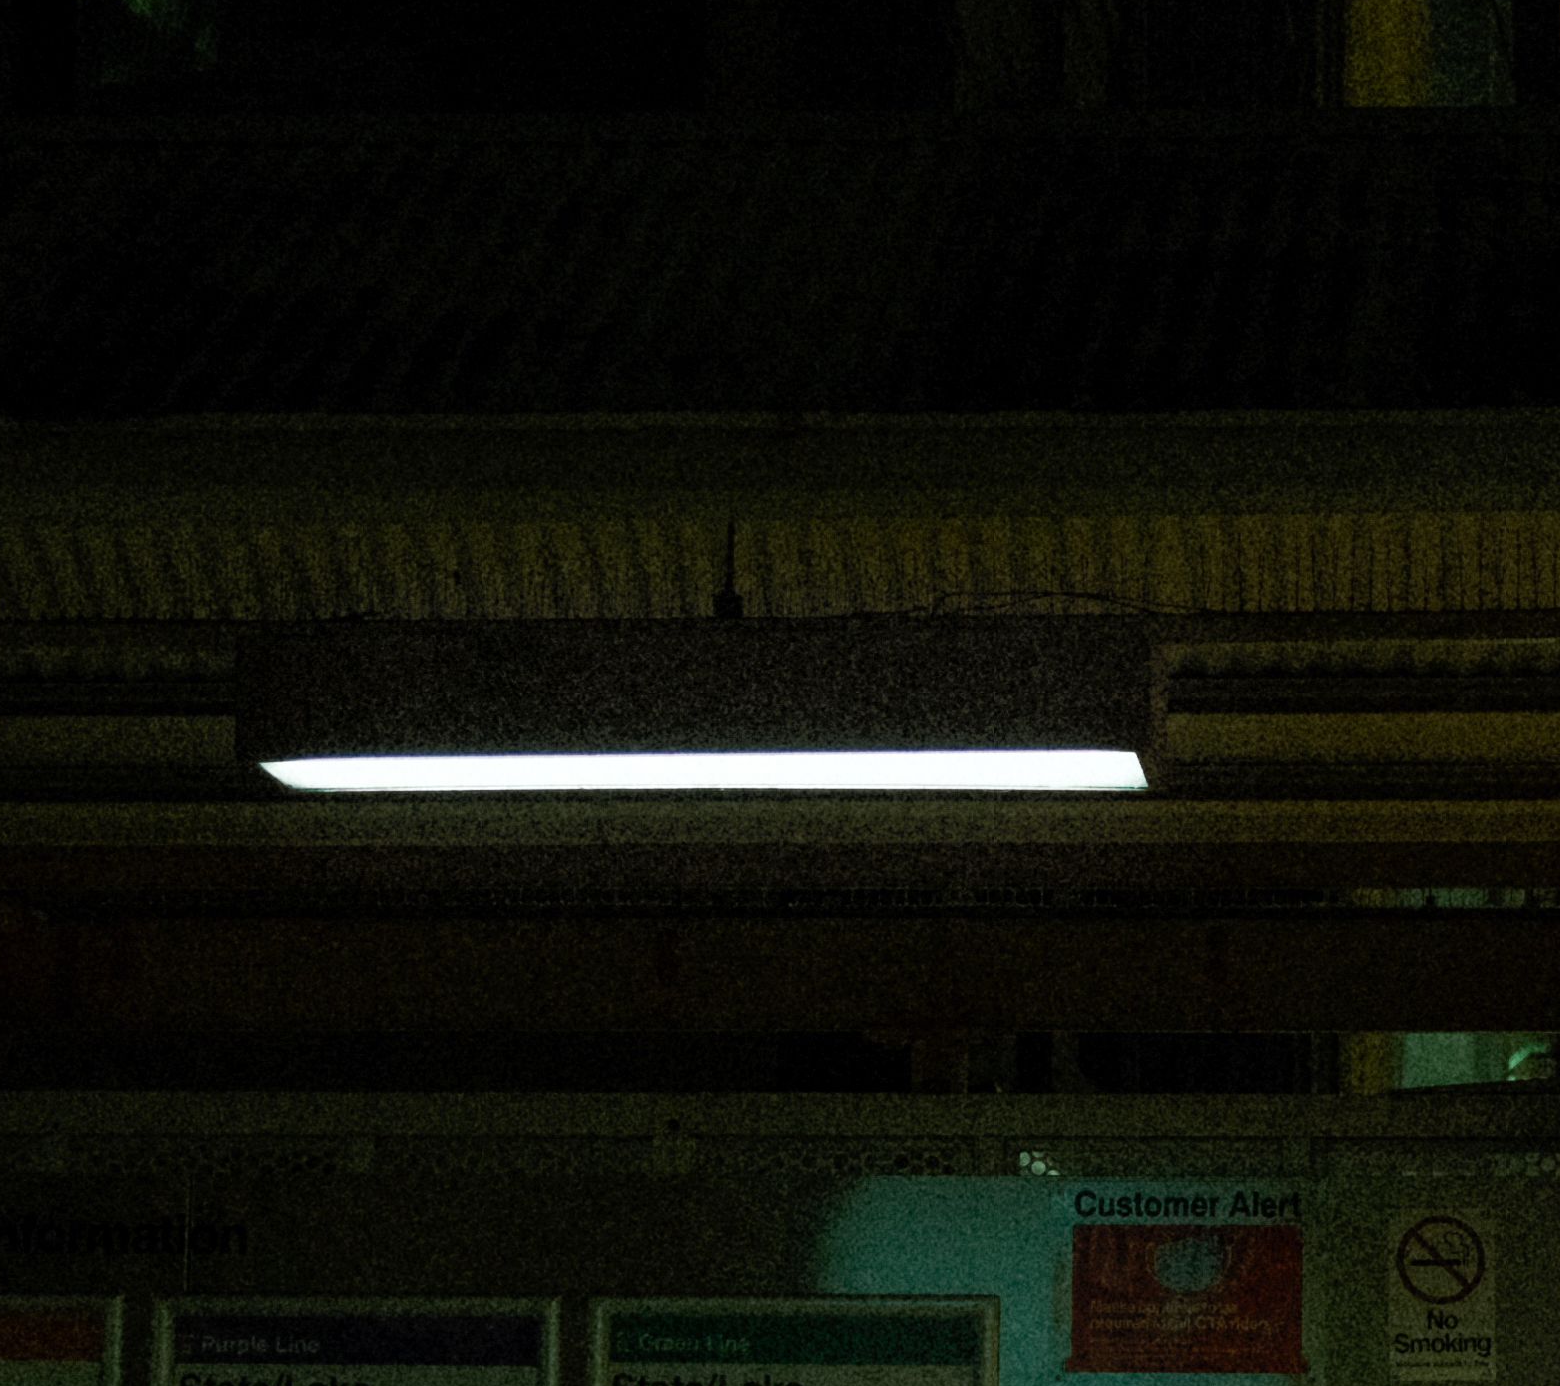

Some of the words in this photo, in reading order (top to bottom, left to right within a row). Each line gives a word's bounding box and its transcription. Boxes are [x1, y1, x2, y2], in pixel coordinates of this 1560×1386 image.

[1073, 1191, 1221, 1218] Customer
[1229, 1190, 1301, 1218] Alert
[1427, 1310, 1459, 1331] No
[274, 1334, 321, 1355] Line
[1394, 1333, 1492, 1357] Smoking
